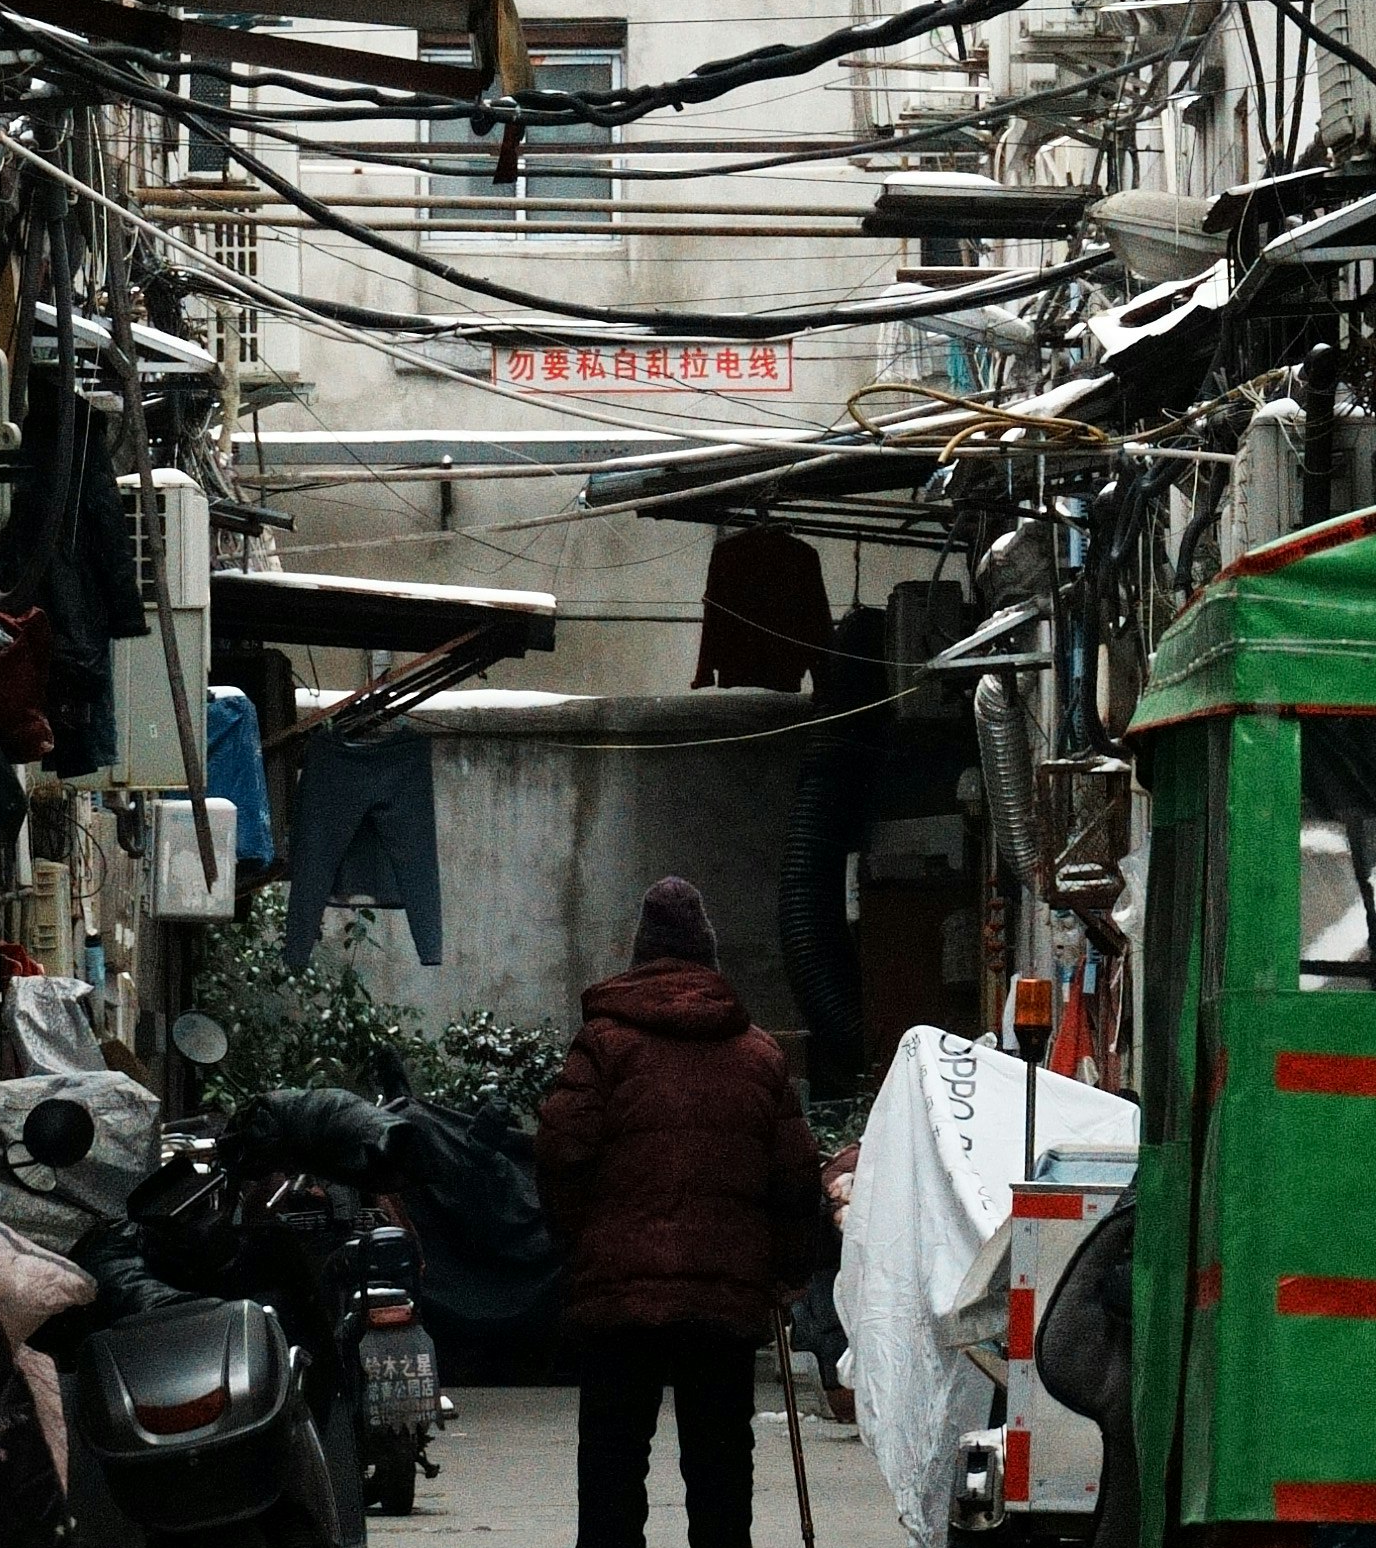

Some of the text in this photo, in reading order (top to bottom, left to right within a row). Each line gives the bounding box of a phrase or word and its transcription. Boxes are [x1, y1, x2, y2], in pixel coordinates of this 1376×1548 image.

[505, 346, 780, 381] 勿要私自乱拉电线
